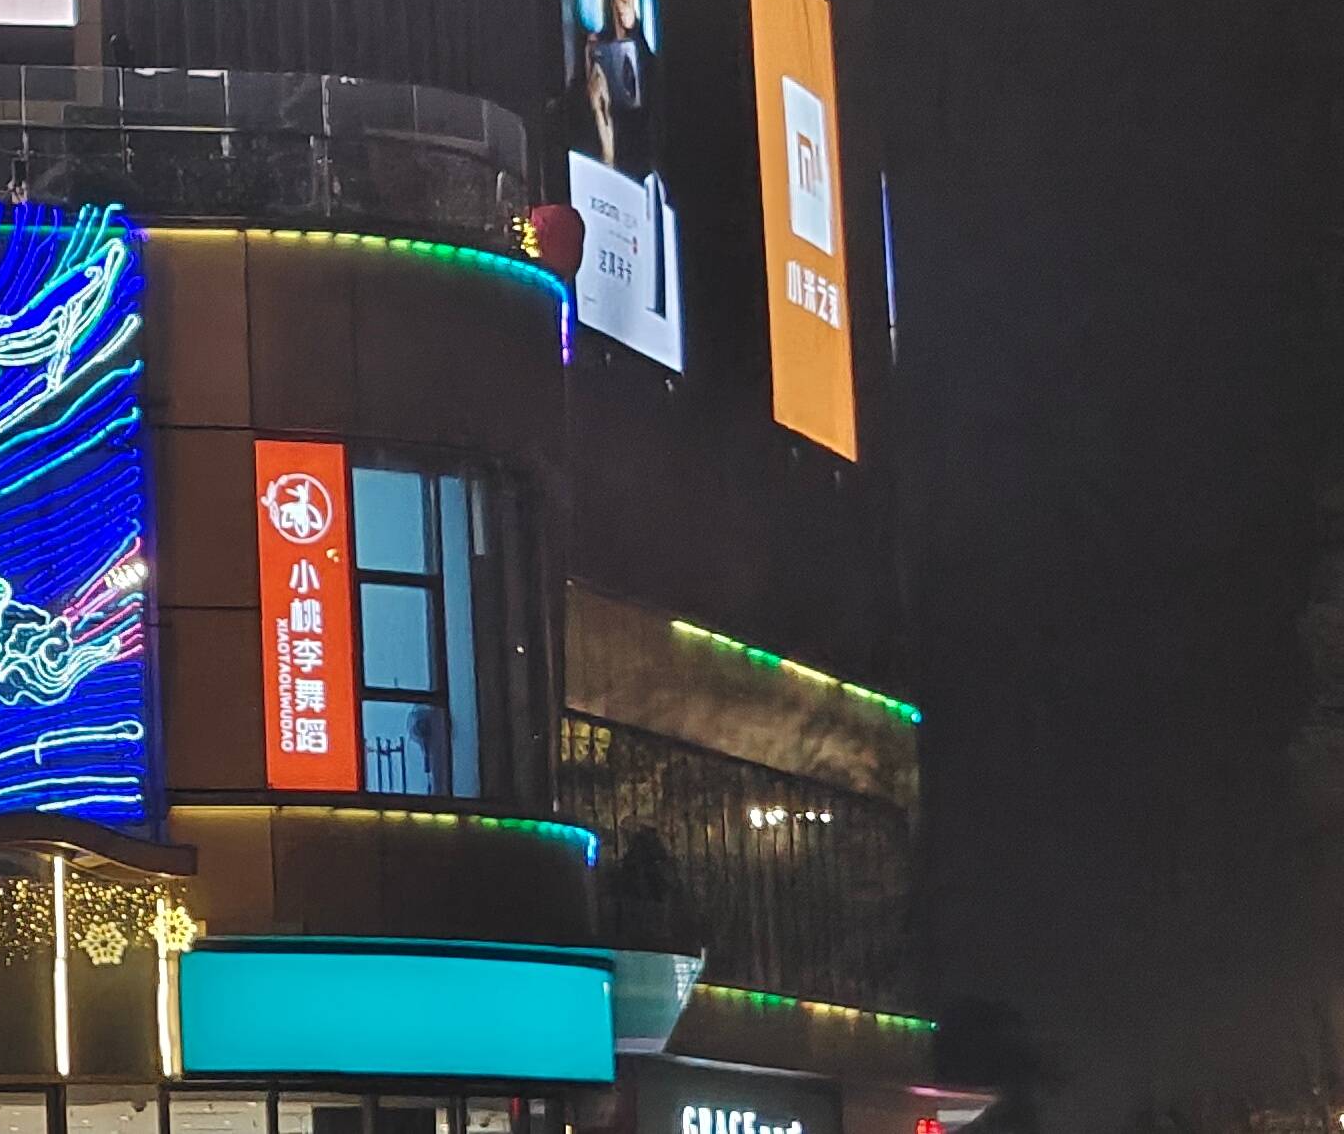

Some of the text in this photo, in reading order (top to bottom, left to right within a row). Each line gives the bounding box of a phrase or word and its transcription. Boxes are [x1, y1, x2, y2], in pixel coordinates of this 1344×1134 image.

[786, 260, 842, 331] 小米之家
[275, 617, 296, 753] XIAOTAOLIWUDAO
[288, 558, 329, 755] 小桃李舞蹈
